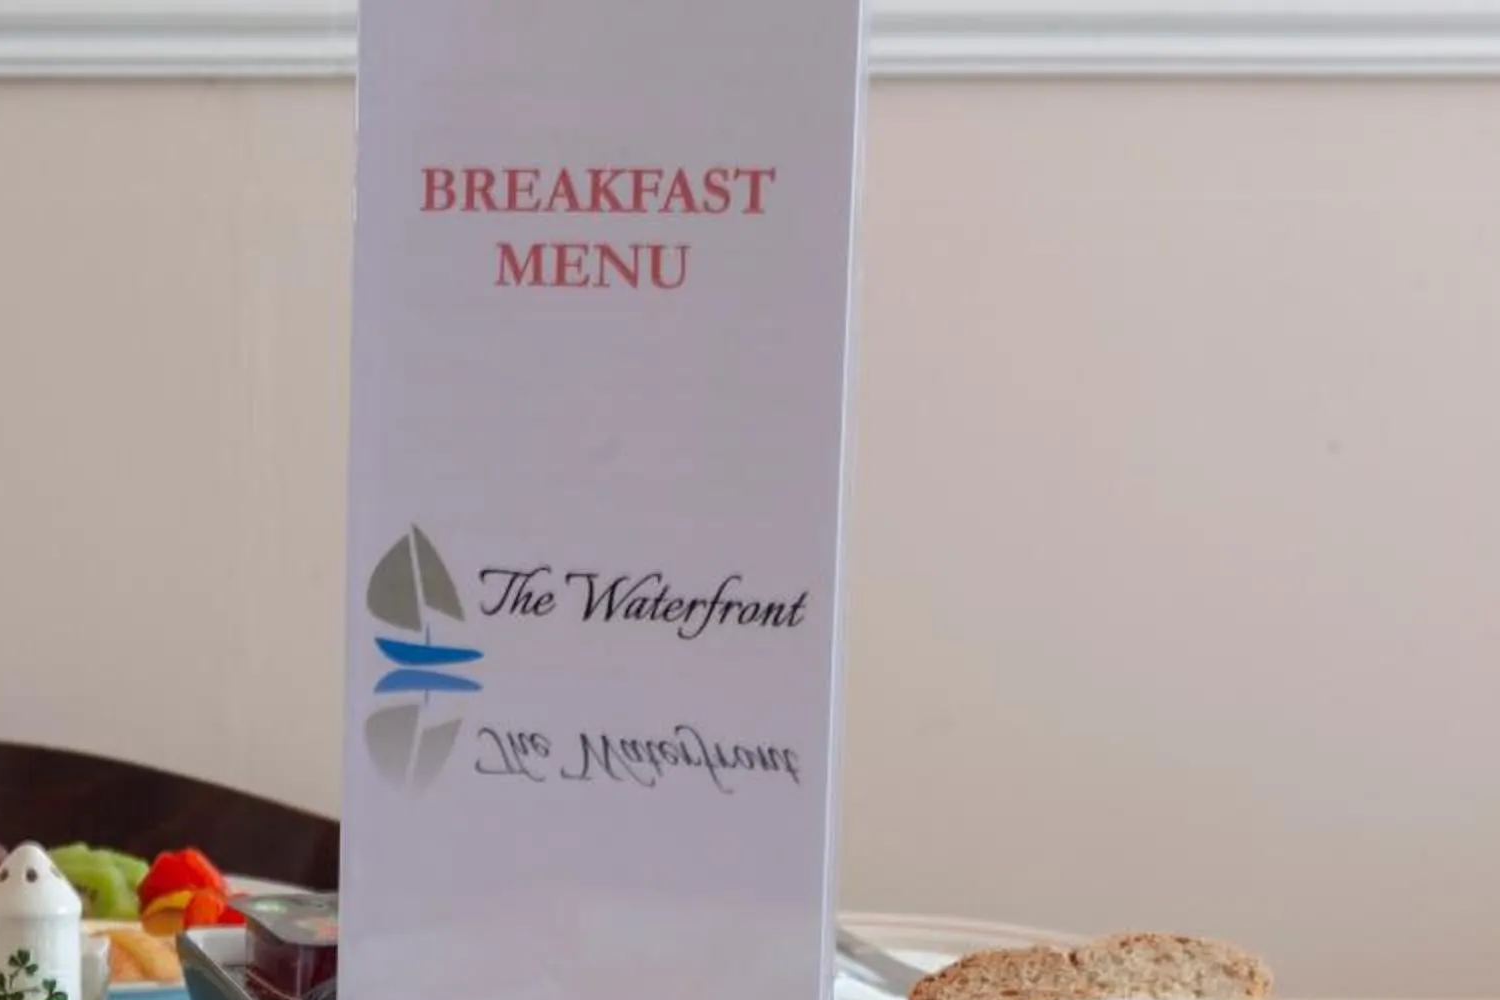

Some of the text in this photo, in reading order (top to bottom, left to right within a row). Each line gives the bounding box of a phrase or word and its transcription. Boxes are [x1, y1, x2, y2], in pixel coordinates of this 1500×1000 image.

[420, 167, 776, 215] BREAKFAST
[494, 242, 691, 290] MENU
[480, 566, 809, 640] The Waterfront
